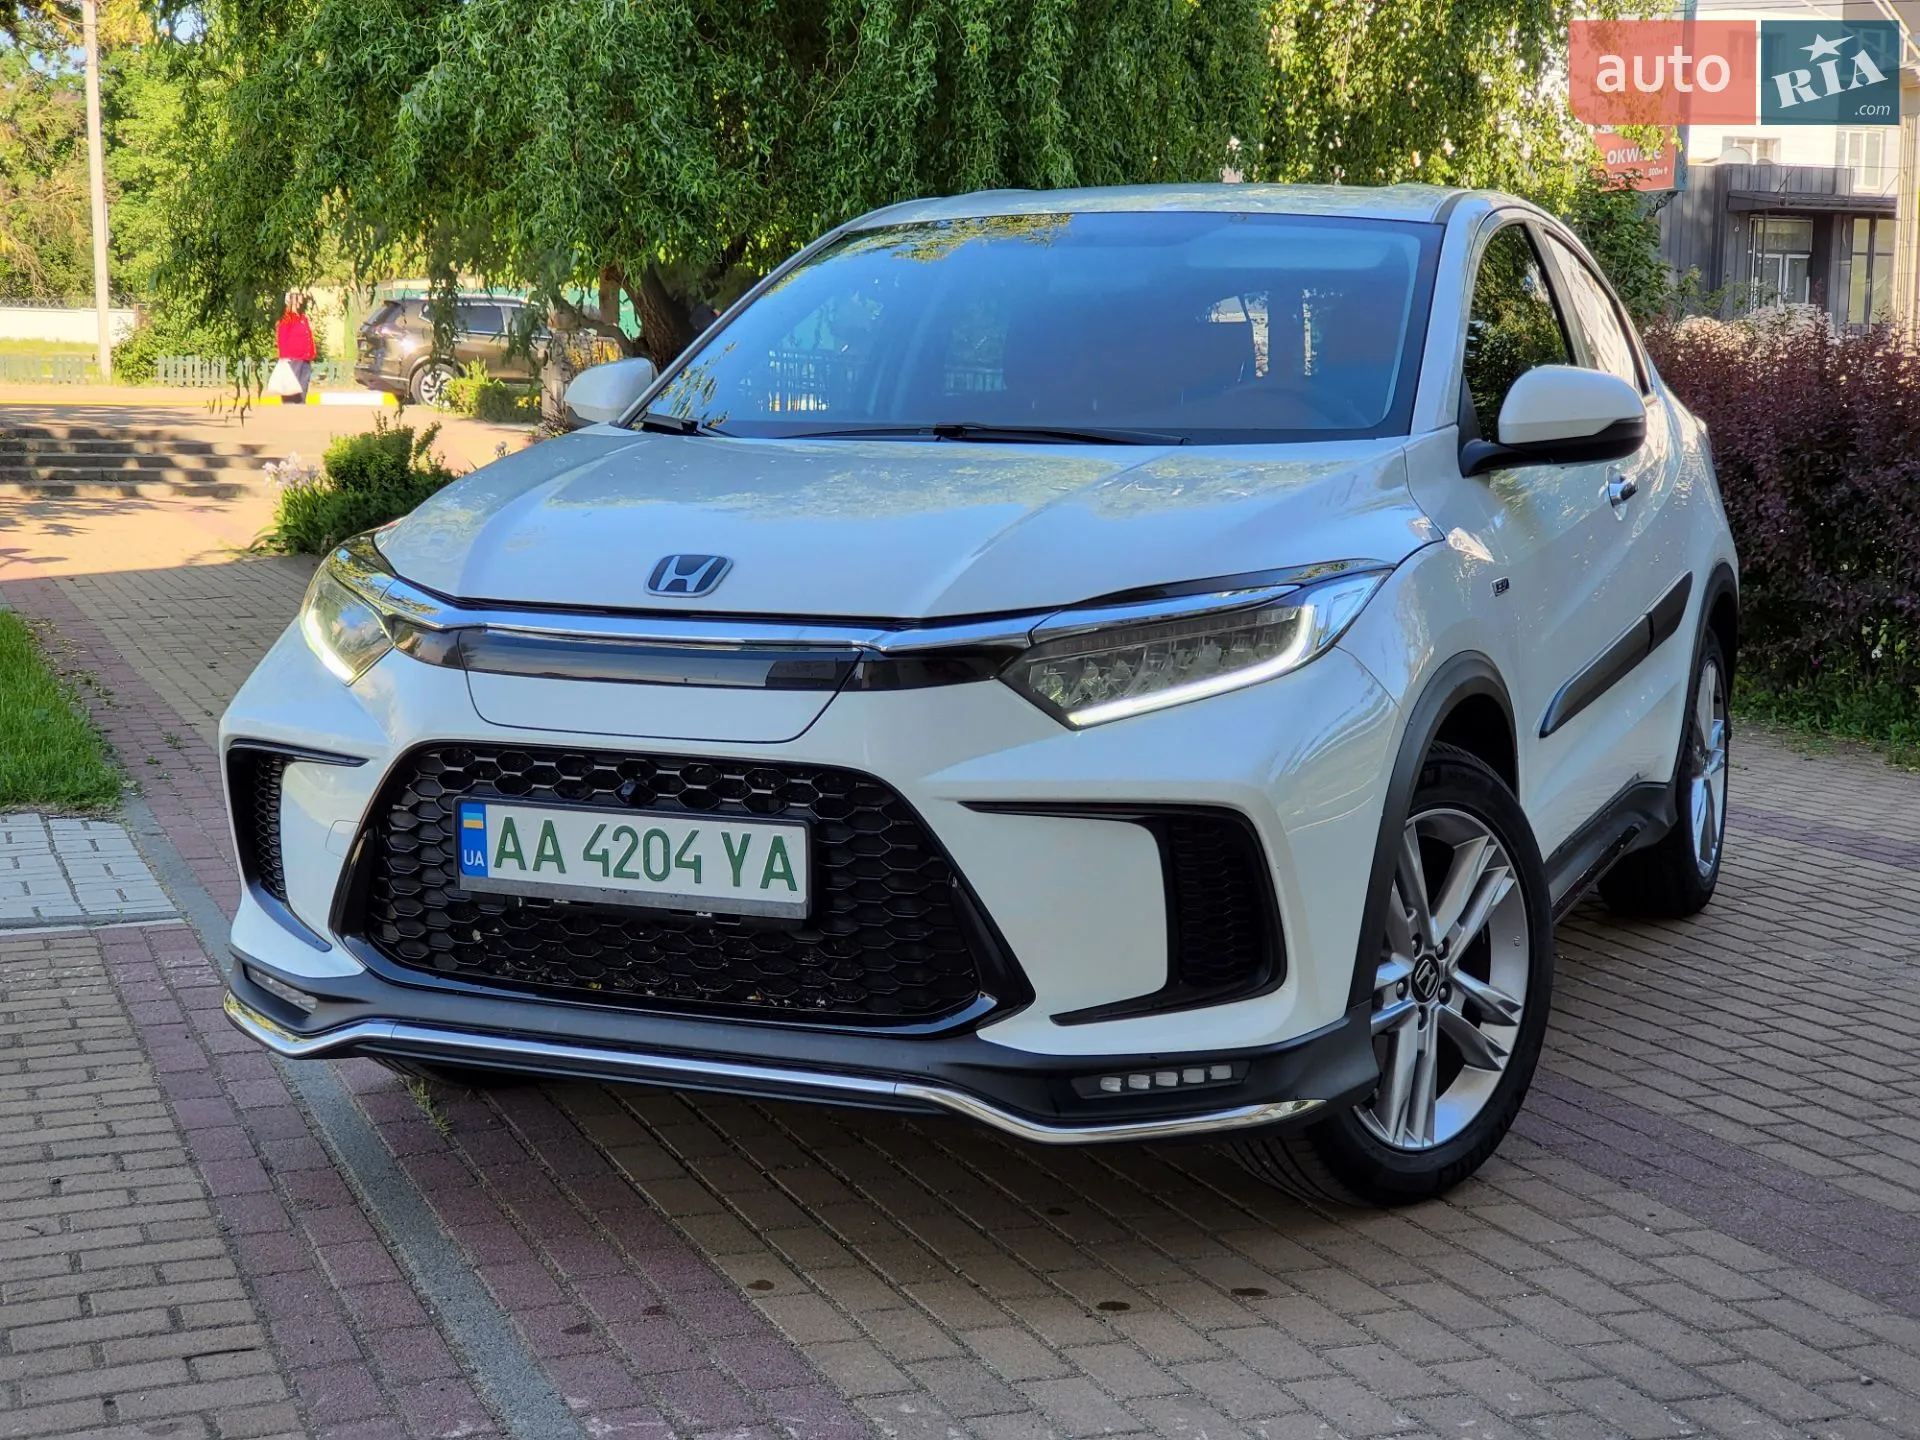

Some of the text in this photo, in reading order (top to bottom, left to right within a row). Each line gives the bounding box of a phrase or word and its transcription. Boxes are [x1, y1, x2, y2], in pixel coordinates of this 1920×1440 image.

[1606, 147, 1662, 165] OKWe
[463, 849, 486, 868] UA
[494, 816, 798, 892] AA 4204 YA
